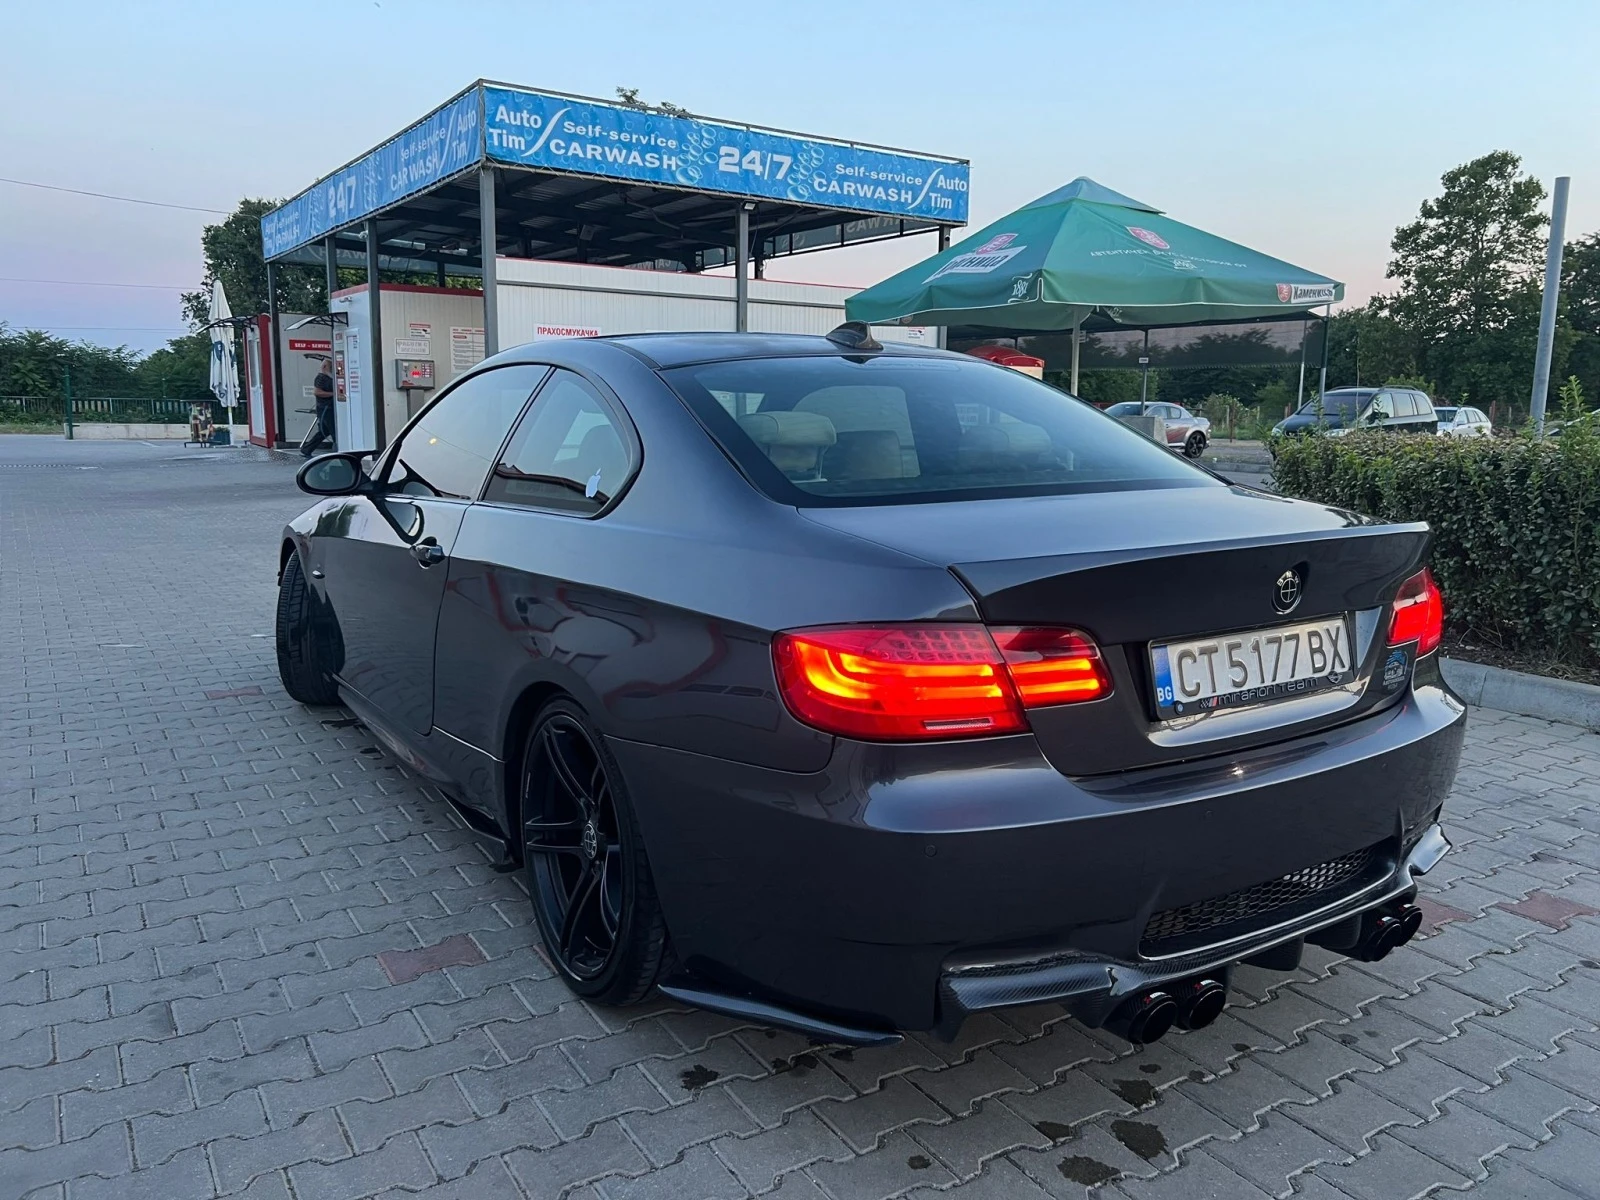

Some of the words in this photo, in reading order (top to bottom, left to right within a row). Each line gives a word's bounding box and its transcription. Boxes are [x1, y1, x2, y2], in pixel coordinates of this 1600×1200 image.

[457, 109, 477, 136] Auto
[495, 105, 542, 129] Auto
[401, 127, 446, 161] Self-service
[488, 128, 526, 150] Tim
[563, 120, 677, 149] Self-service
[452, 139, 468, 161] Tim
[550, 138, 677, 171] CARWASH
[718, 146, 792, 180] 24/7
[835, 163, 923, 186] Self-service
[813, 178, 913, 204] CARWASH
[936, 174, 967, 192] Auto
[928, 192, 953, 210] Tim
[537, 326, 599, 337] ПРАХОСМУКАЧКА
[1176, 646, 1219, 698] CT
[1224, 633, 1301, 689] 5177
[1307, 626, 1346, 674] BX
[1156, 686, 1172, 702] BG
